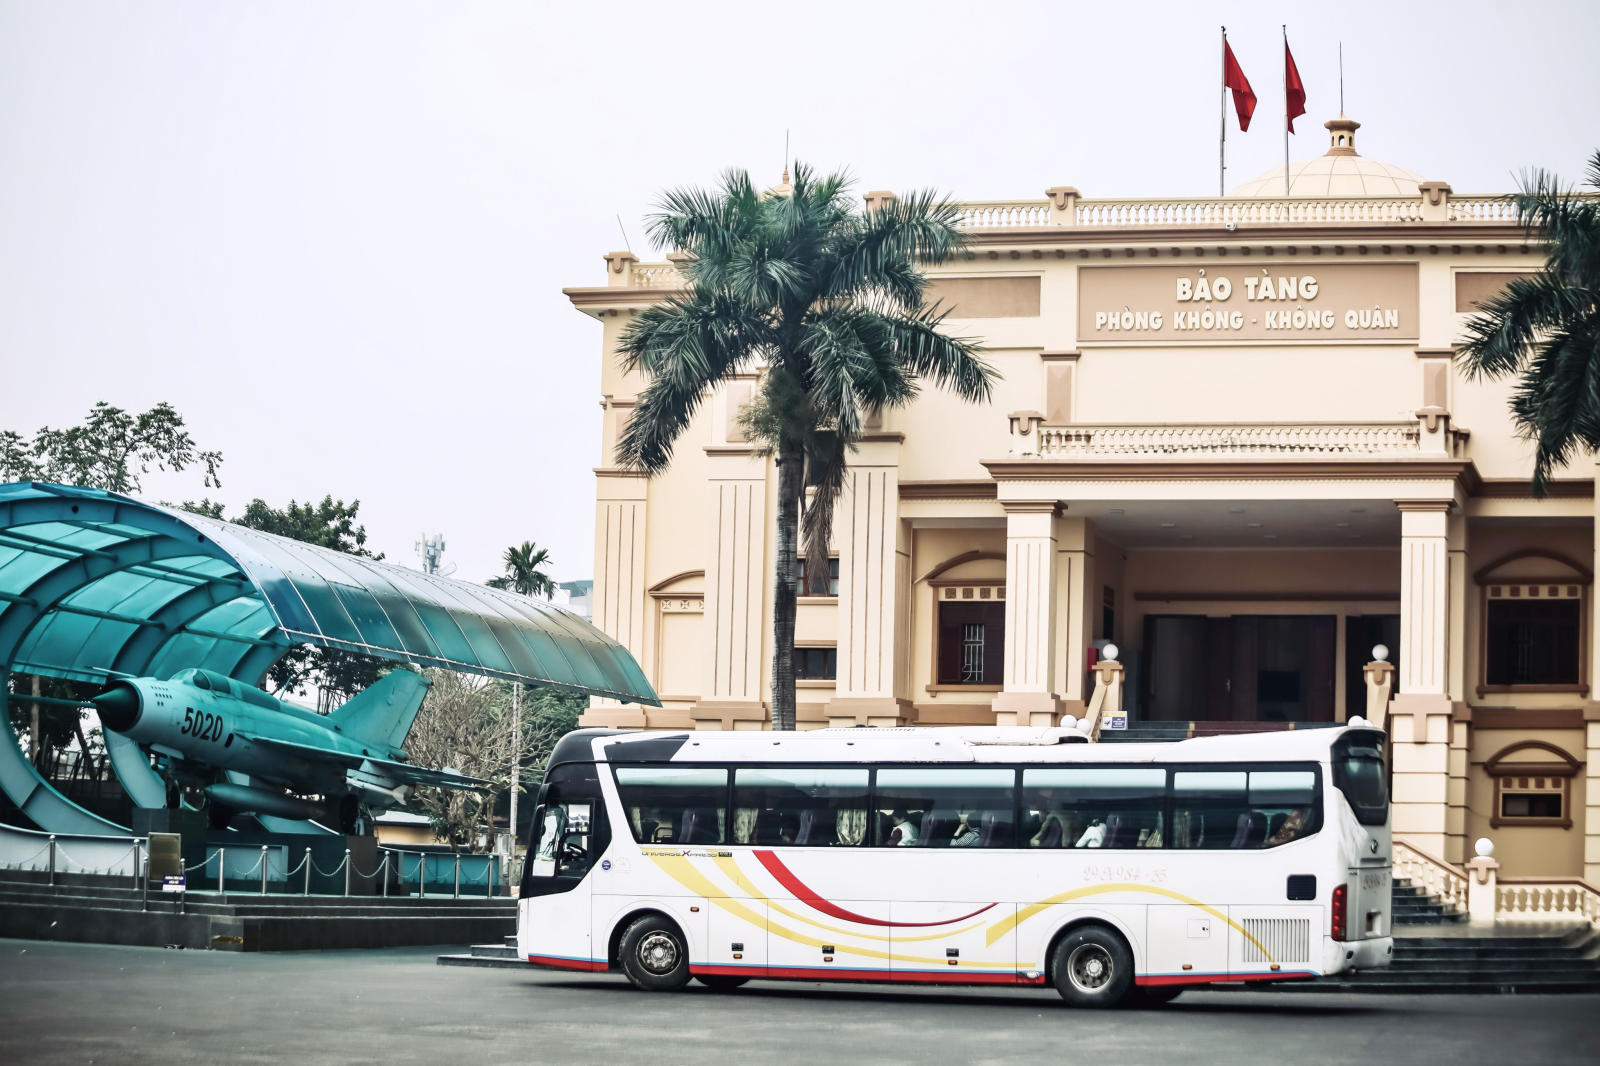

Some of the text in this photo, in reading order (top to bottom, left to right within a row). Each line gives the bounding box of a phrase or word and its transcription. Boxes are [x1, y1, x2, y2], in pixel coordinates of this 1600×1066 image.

[1176, 268, 1319, 302] BẢO TÀNG
[1095, 306, 1163, 331] PHÒNG
[1173, 305, 1244, 331] KHÔNG
[1265, 304, 1335, 330] KHÔNG
[1344, 304, 1399, 331] QUÂN
[181, 706, 224, 743] 5020
